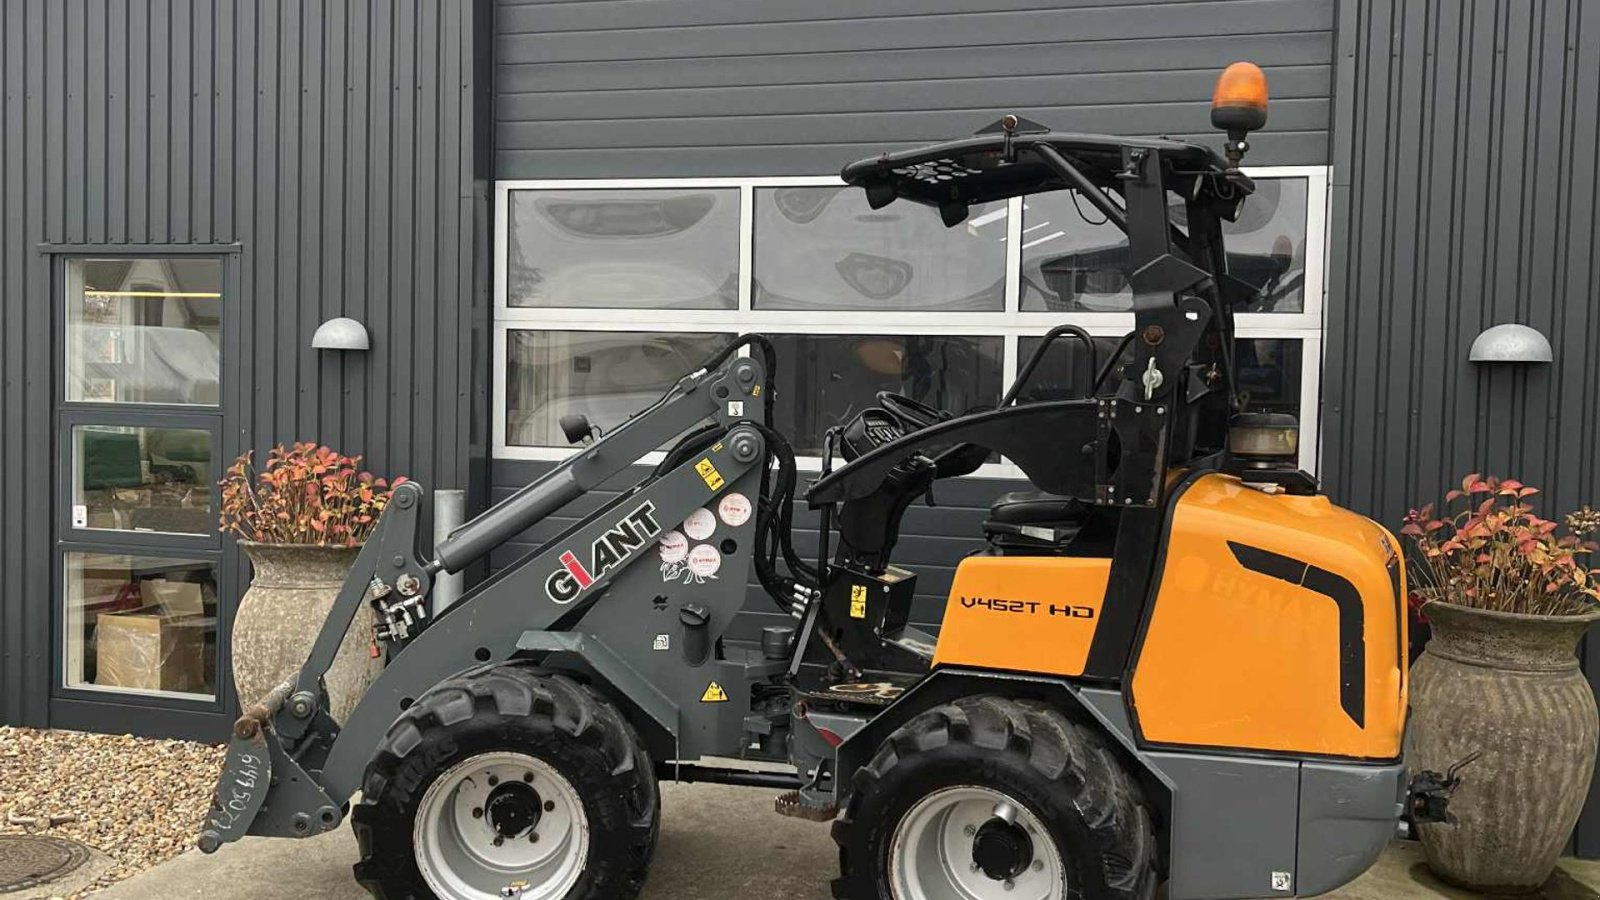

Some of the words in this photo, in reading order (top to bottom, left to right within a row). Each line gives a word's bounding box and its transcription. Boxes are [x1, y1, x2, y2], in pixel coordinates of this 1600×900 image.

[545, 499, 661, 604] GIANT
[961, 596, 1041, 614] V452T
[1049, 603, 1094, 619] HD
